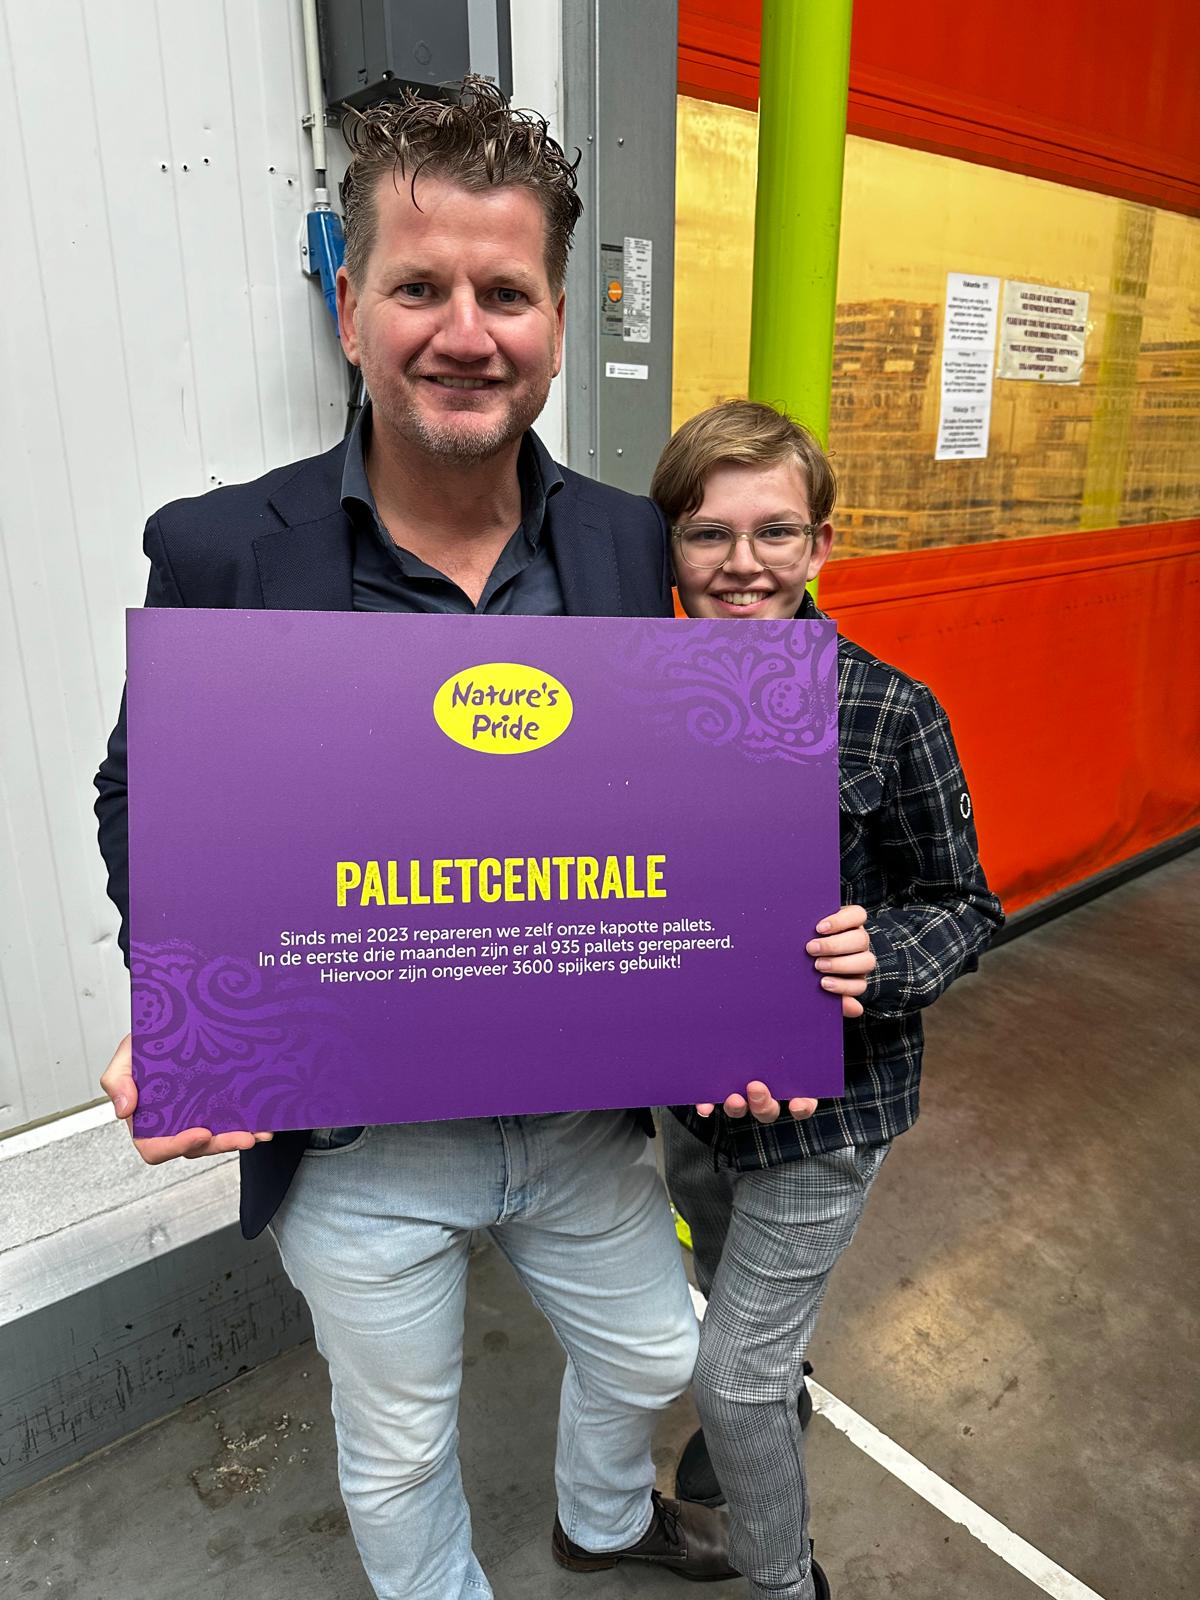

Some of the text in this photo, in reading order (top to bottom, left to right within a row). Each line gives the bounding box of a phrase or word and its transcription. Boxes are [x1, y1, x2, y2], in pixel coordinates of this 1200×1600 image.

[452, 681, 559, 708] Nature's
[472, 714, 540, 740] Pride
[336, 854, 667, 908] PALLETCENTRALE
[280, 918, 716, 947] Sinds mei 2023 repareren we zelf onze kapotte pallets.
[259, 934, 735, 967] In de eerste drie maanden zijn er al 935 pallets gerepareerd.
[320, 954, 681, 984] Hiervoor zijn ongeveer 3600 spijkers gebuikt!
